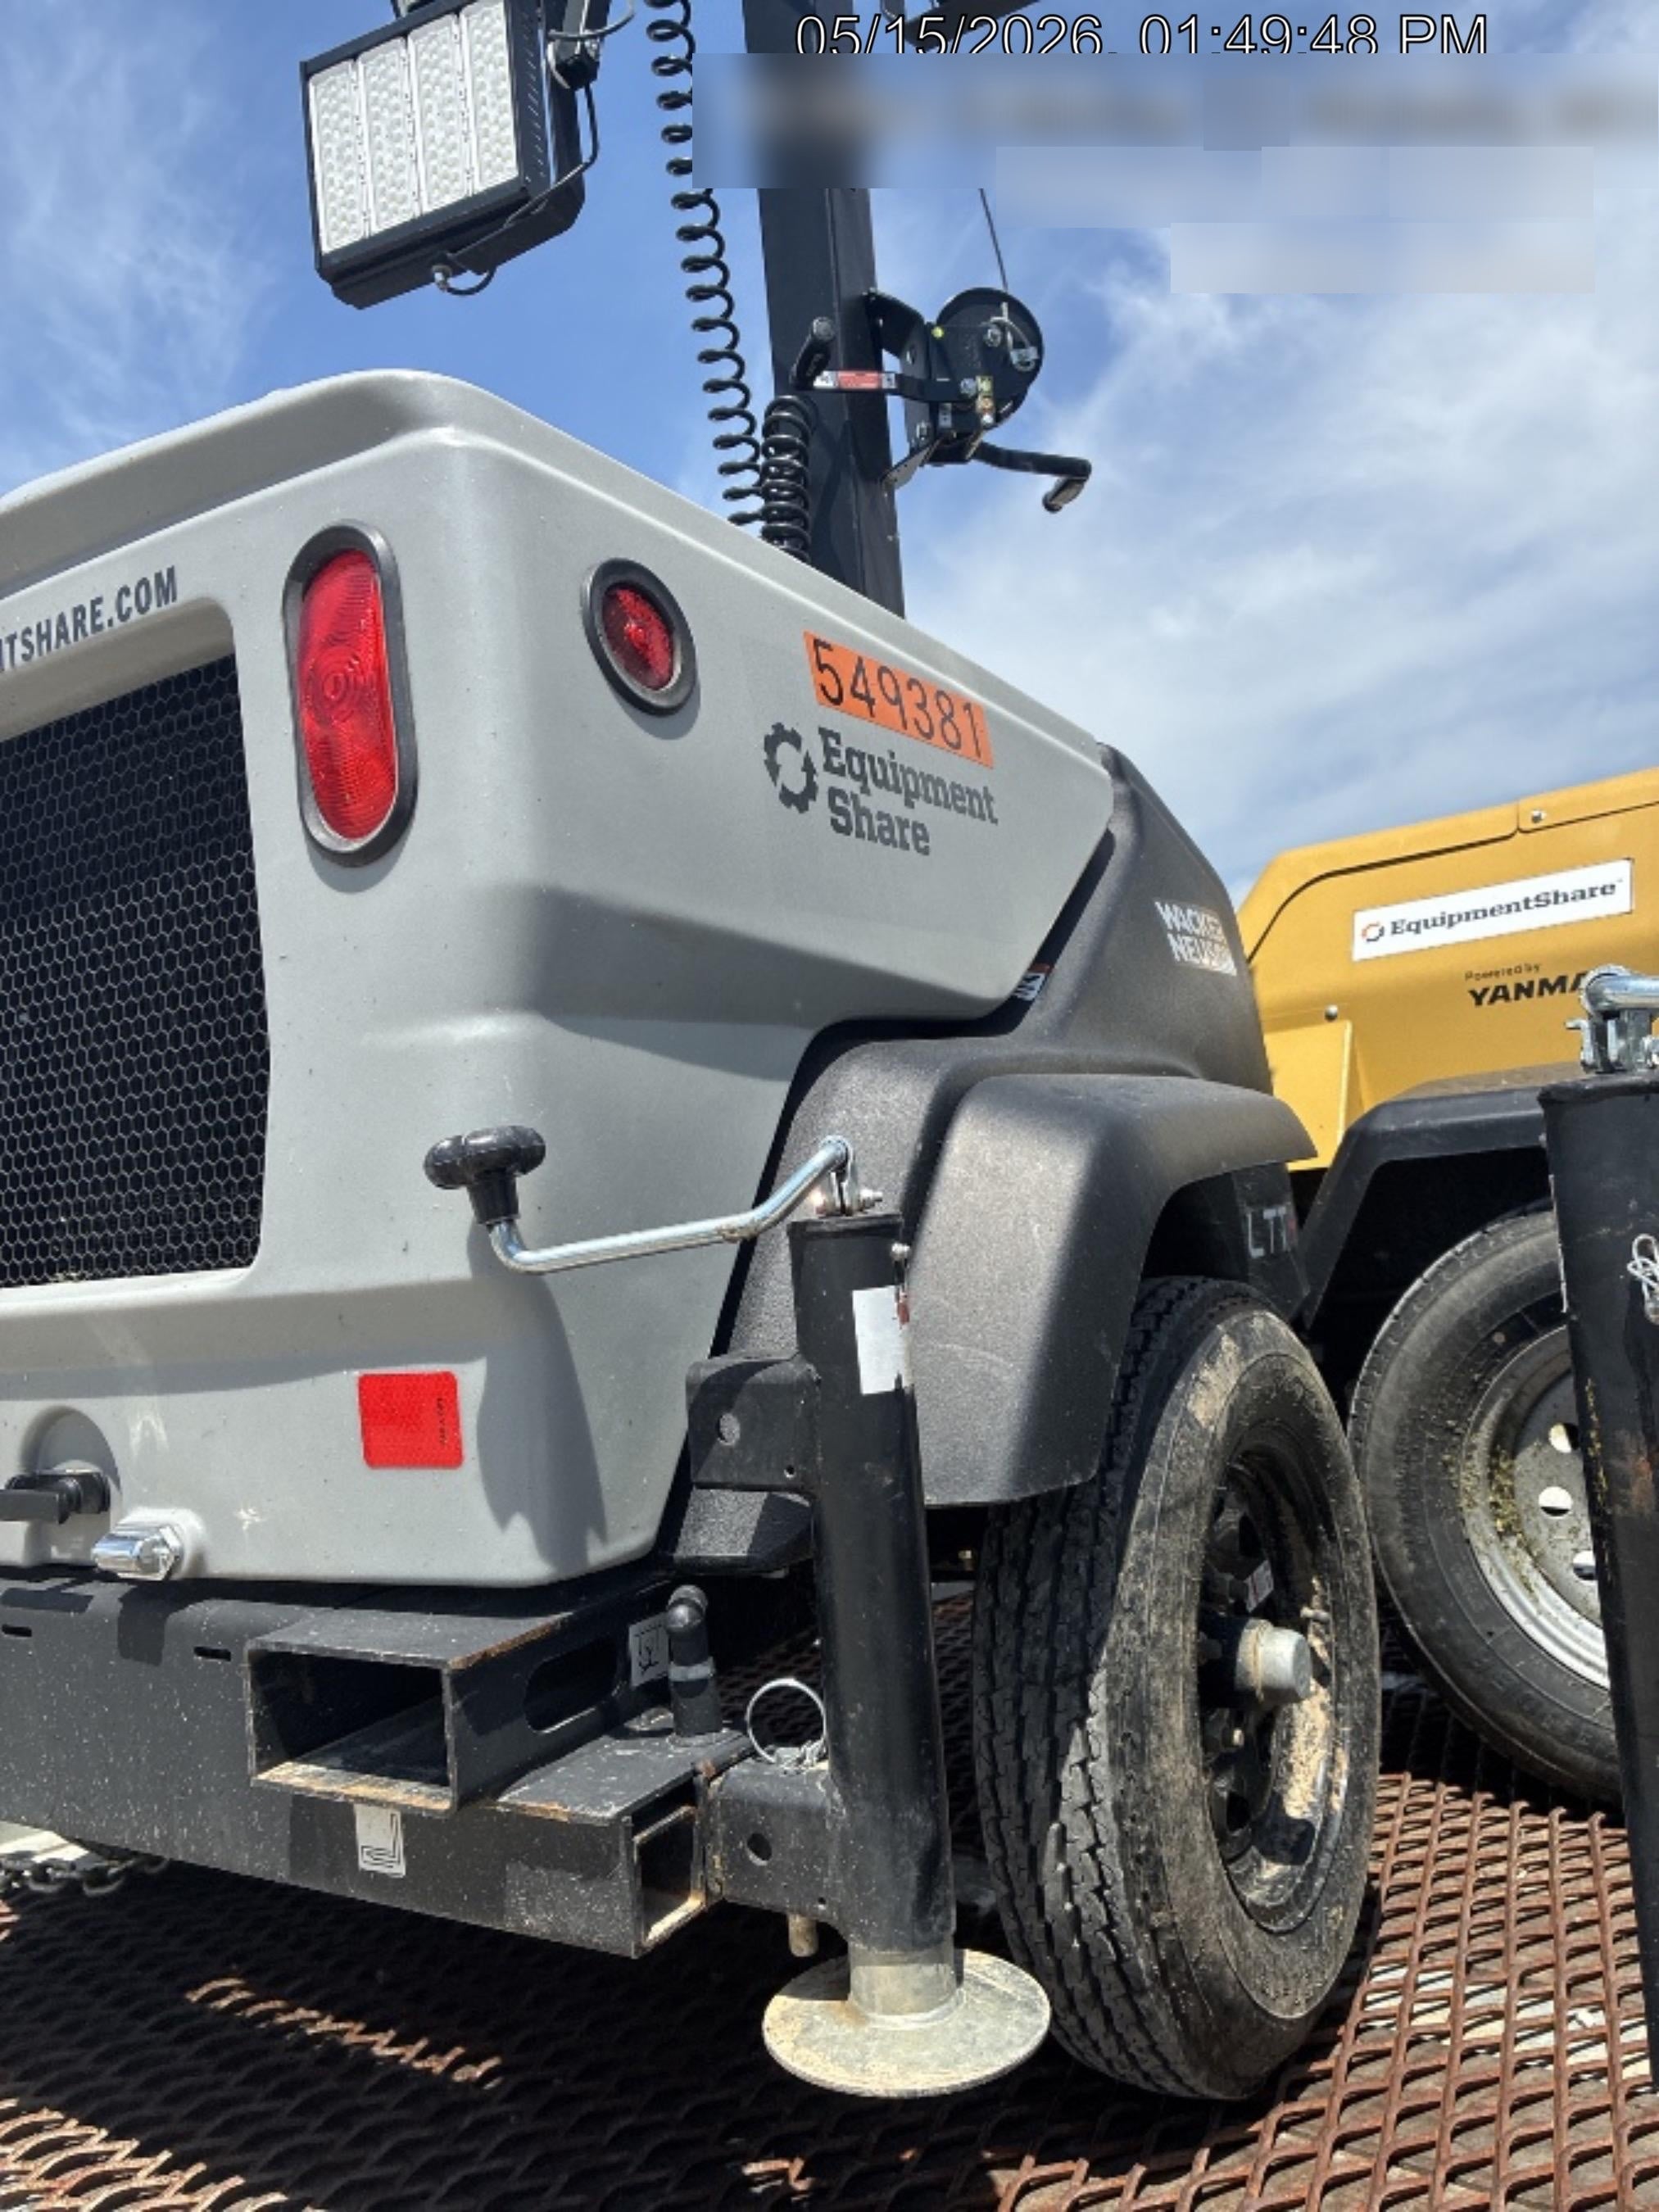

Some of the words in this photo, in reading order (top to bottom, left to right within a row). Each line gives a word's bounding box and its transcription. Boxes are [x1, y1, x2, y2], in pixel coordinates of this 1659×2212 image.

[813, 637, 982, 759] 549381
[818, 726, 999, 825] Equipment
[827, 786, 931, 856] Share
[1390, 882, 1617, 936] EquipmentShare
